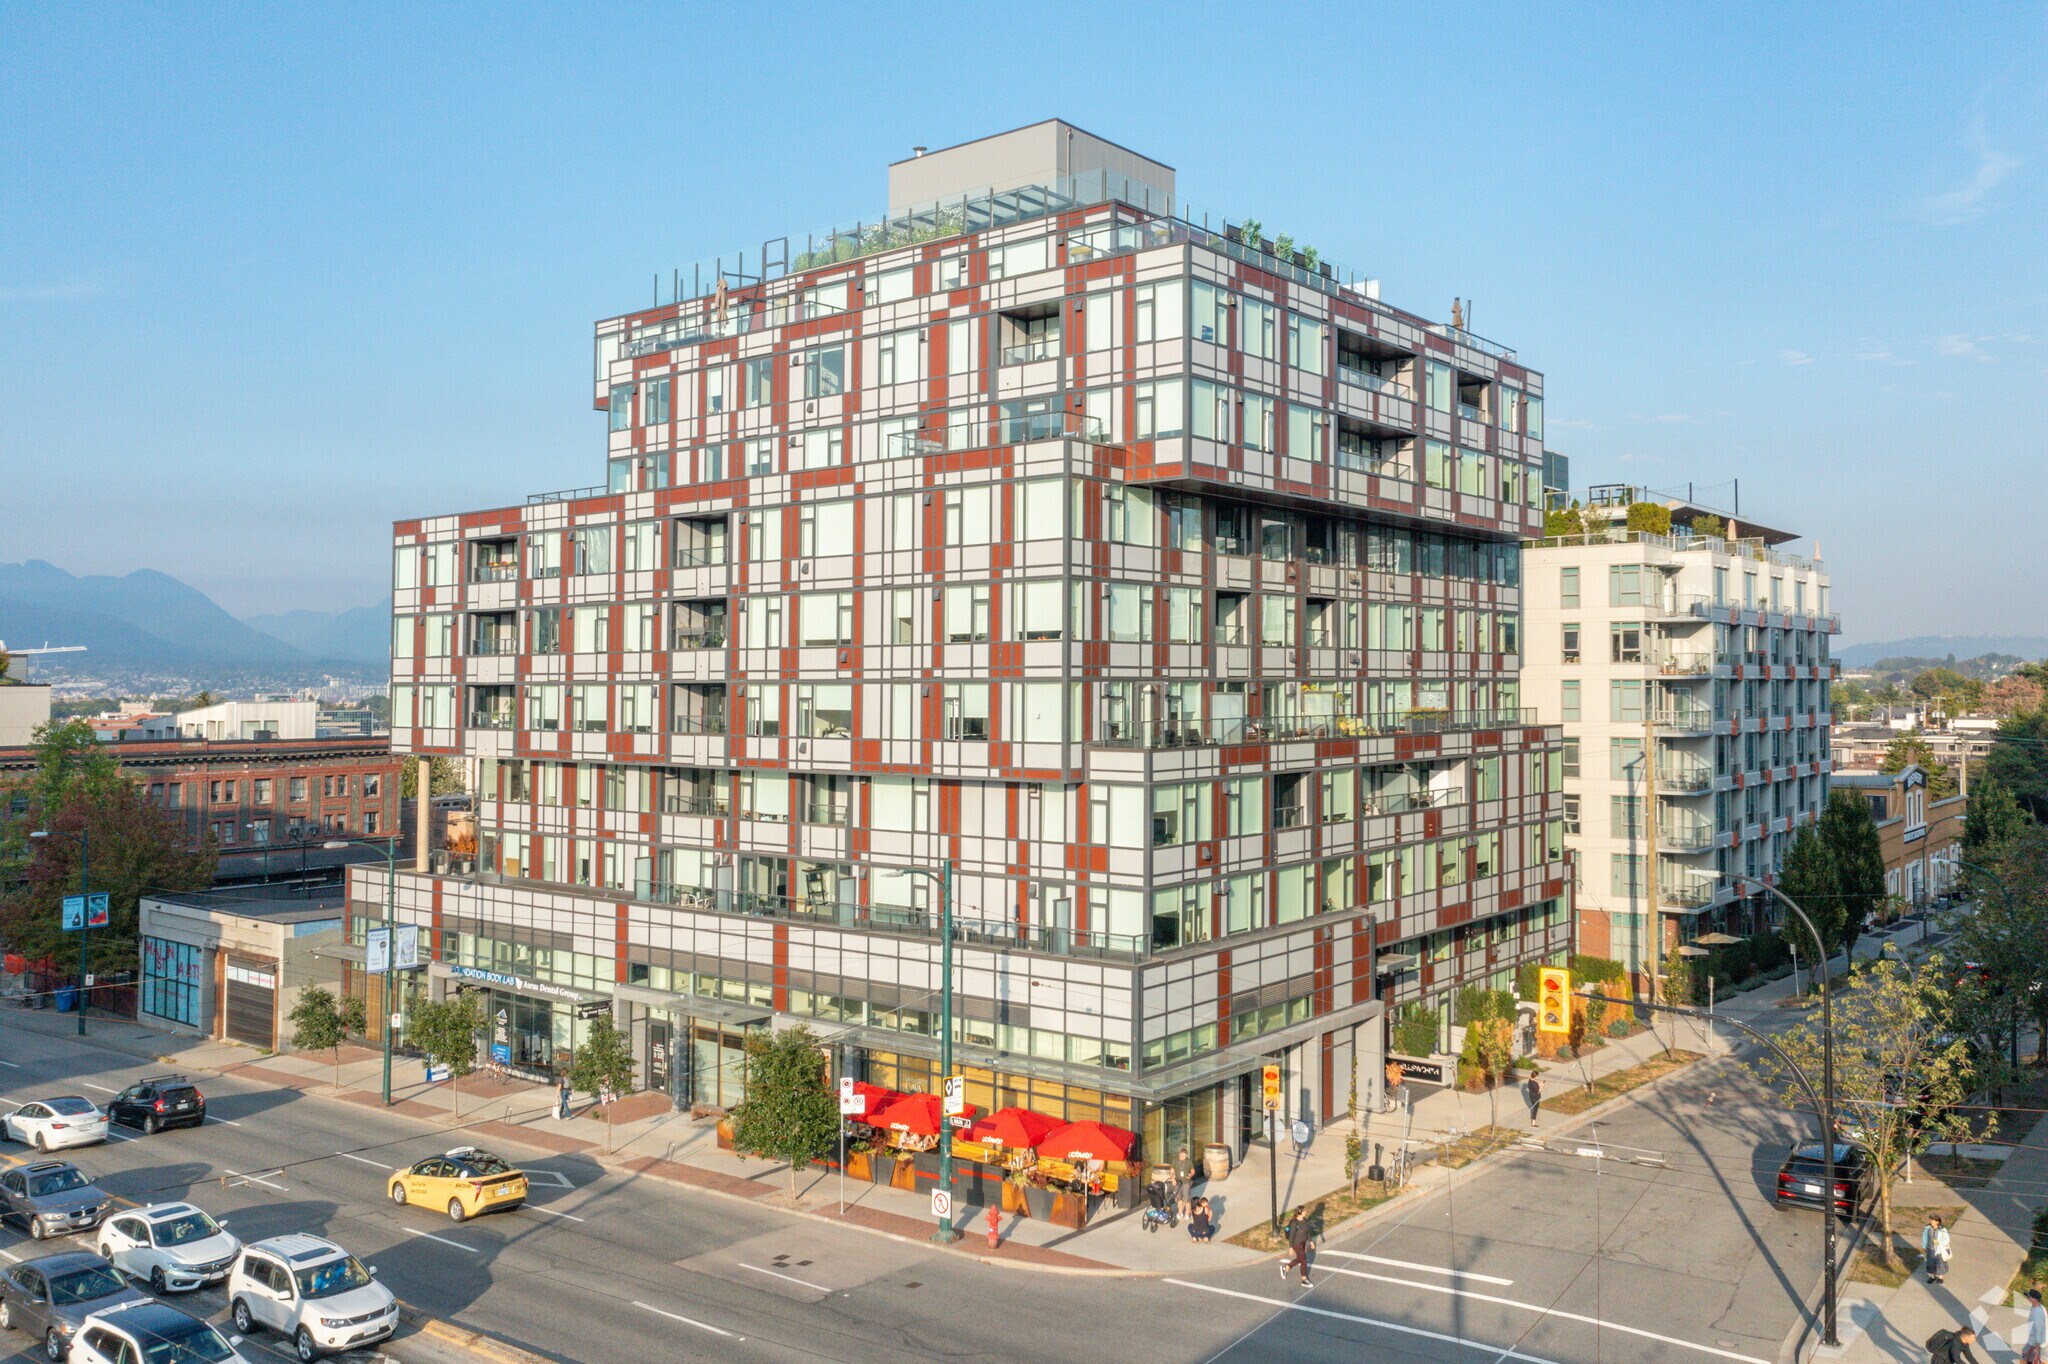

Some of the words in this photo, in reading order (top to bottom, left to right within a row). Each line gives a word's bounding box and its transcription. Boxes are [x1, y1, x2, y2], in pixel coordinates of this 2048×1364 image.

[145, 941, 175, 961] MAIN
[451, 965, 486, 980] FOUNDATION
[486, 970, 503, 985] BODY
[503, 974, 516, 986] LAB
[540, 983, 559, 995] Dental
[559, 987, 579, 1001] Group
